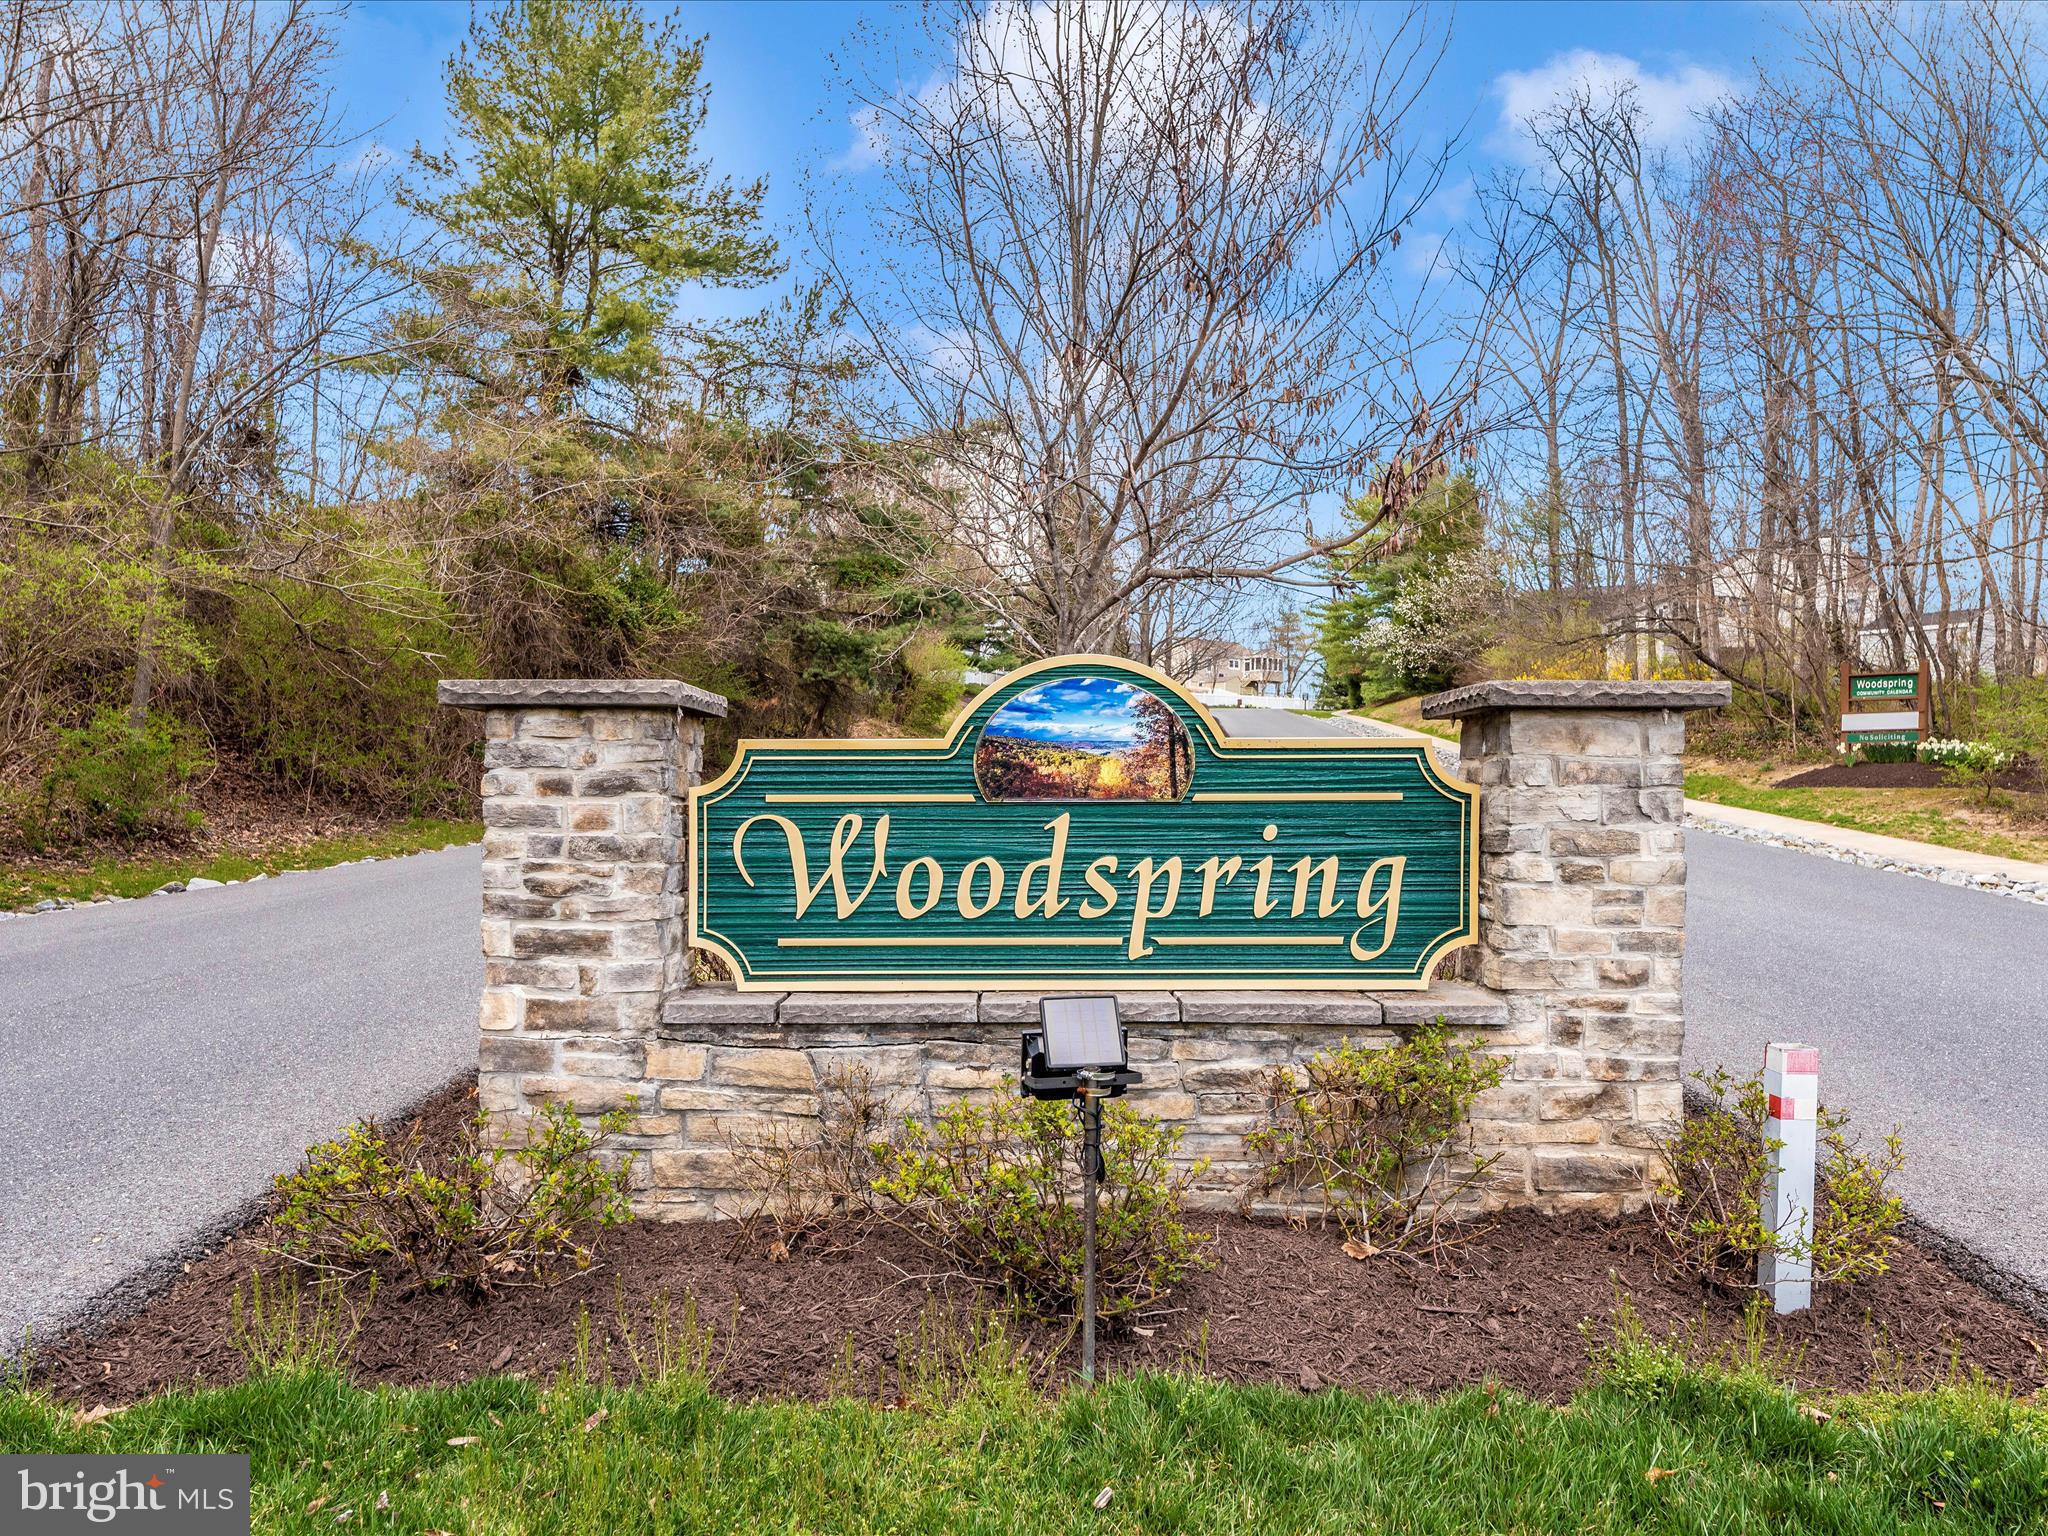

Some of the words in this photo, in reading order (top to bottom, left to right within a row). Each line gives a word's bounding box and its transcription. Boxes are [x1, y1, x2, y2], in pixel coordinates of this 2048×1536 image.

[1856, 678, 1913, 690] Woodspring
[1869, 733, 1906, 741] Soliciting
[732, 812, 1408, 961] Woodspring
